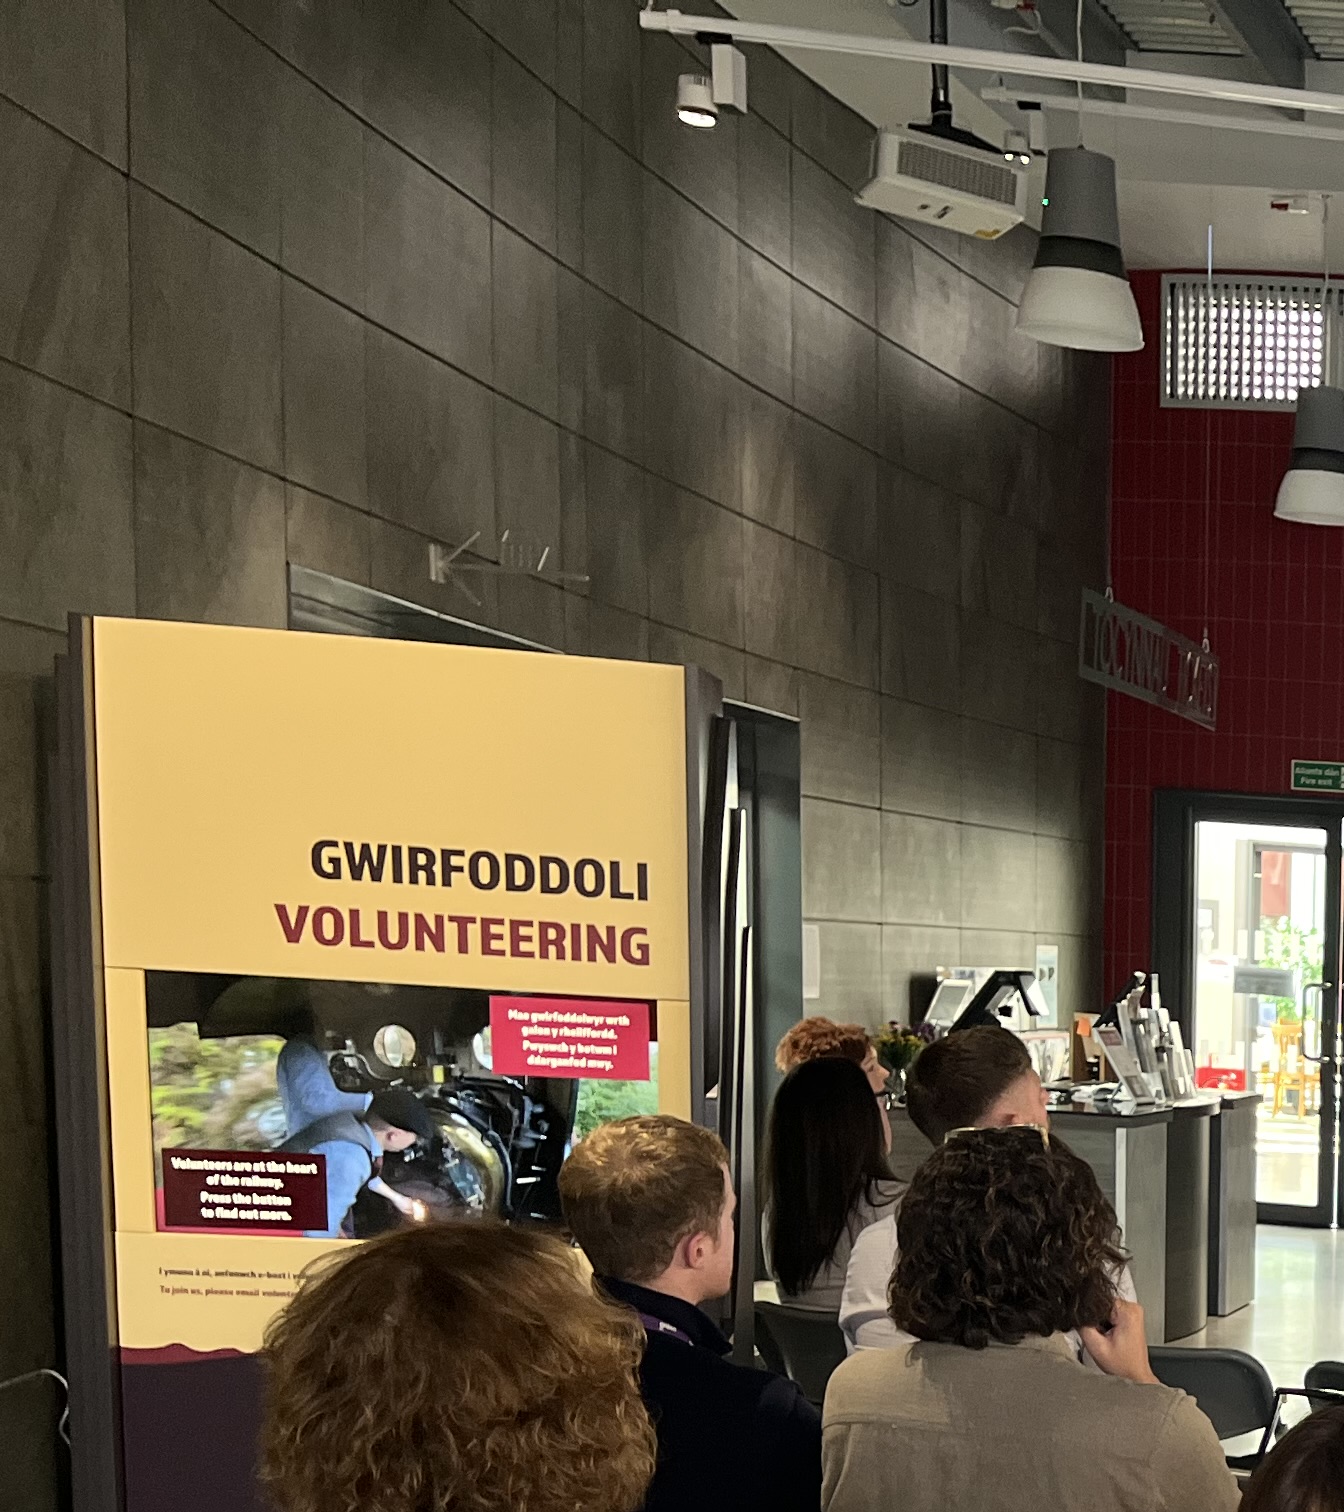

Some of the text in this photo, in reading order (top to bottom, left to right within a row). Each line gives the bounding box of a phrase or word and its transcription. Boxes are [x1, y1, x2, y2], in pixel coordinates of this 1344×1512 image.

[310, 839, 649, 901] GWIRFODDOLI
[273, 903, 651, 967] VOLUNTEERING
[170, 1157, 318, 1175] Volunteers are at the heart
[205, 1173, 285, 1190] of the railway.
[200, 1191, 292, 1206] Press the button
[200, 1206, 293, 1221] to find out more.
